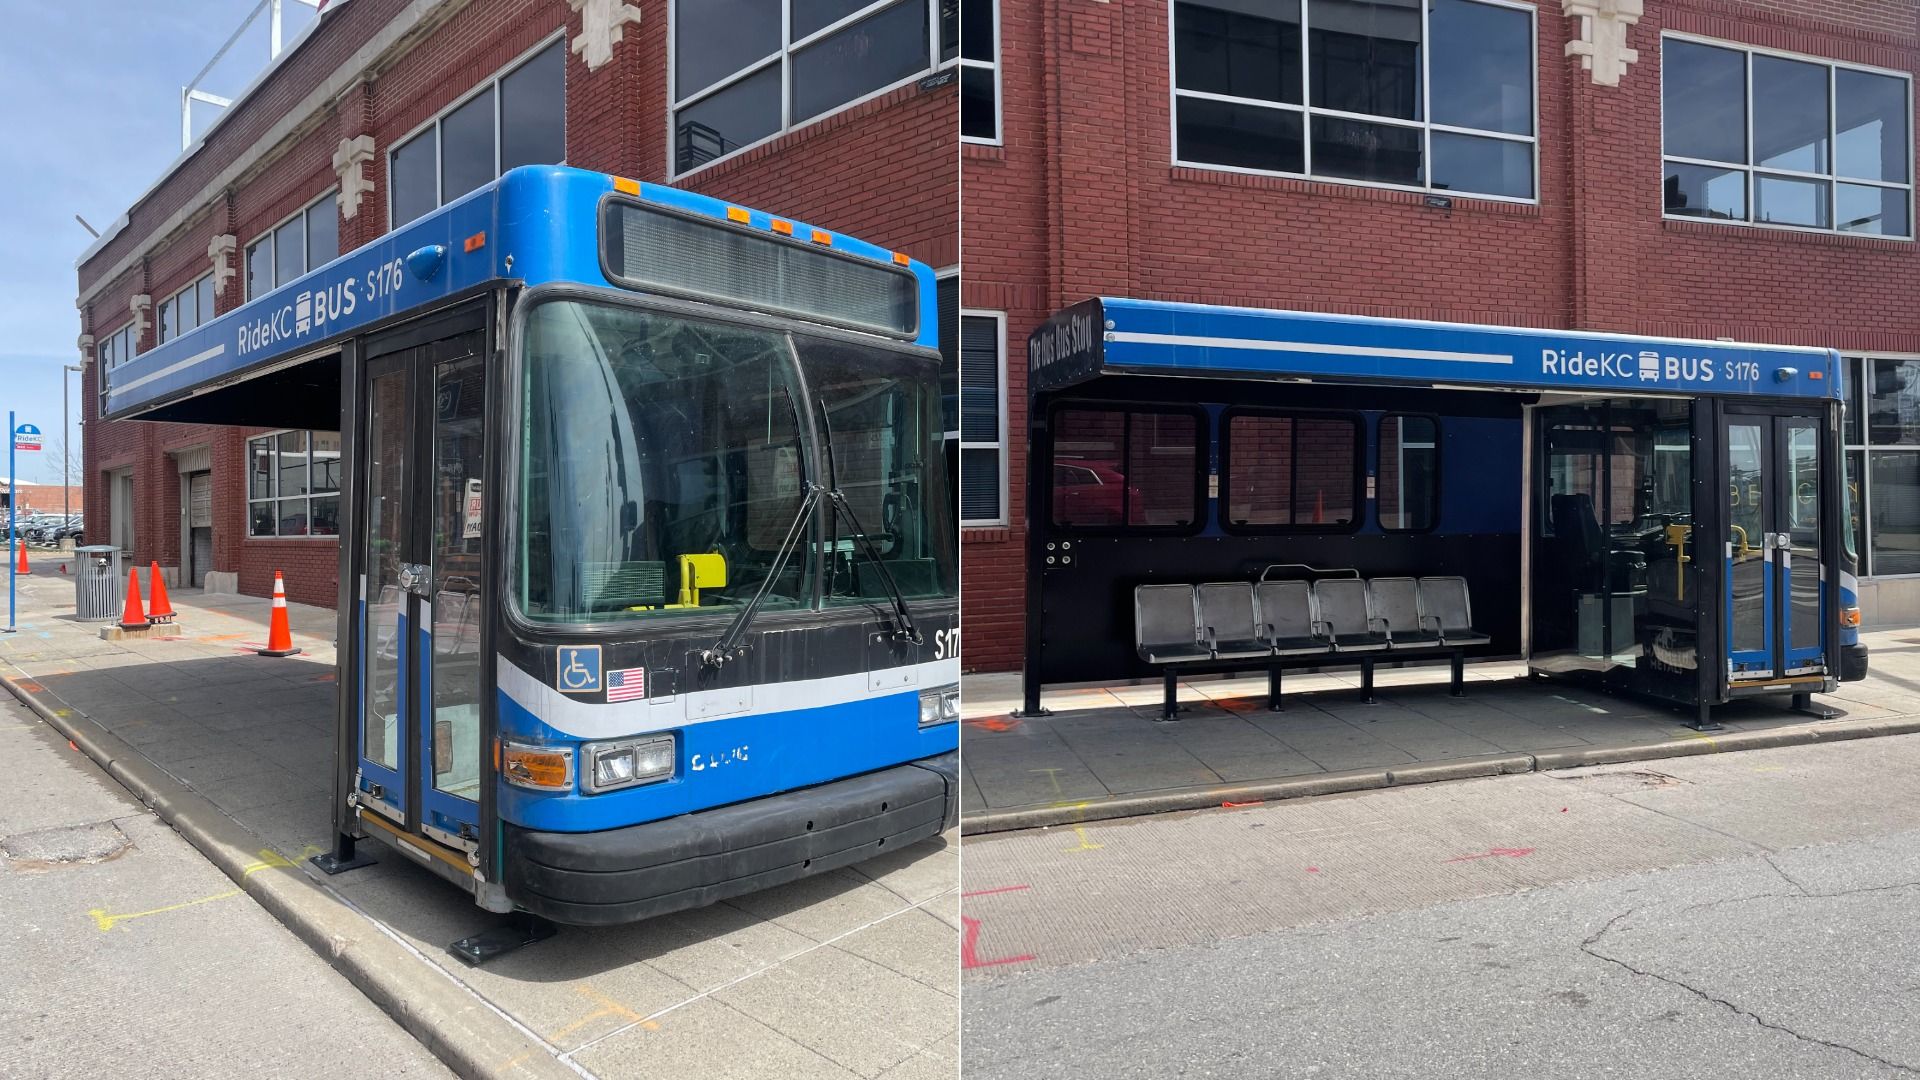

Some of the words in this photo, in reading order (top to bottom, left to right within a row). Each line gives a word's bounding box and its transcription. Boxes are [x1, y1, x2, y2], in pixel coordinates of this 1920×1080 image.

[238, 306, 293, 356] RideKC
[314, 277, 356, 327] BUS
[367, 257, 403, 302] S176
[1055, 324, 1071, 360] Bus
[1071, 314, 1092, 354] Stop
[1541, 349, 1634, 378] RideKC
[1665, 356, 1714, 381] BUS
[1725, 361, 1760, 381] S176
[934, 627, 960, 660] S17
